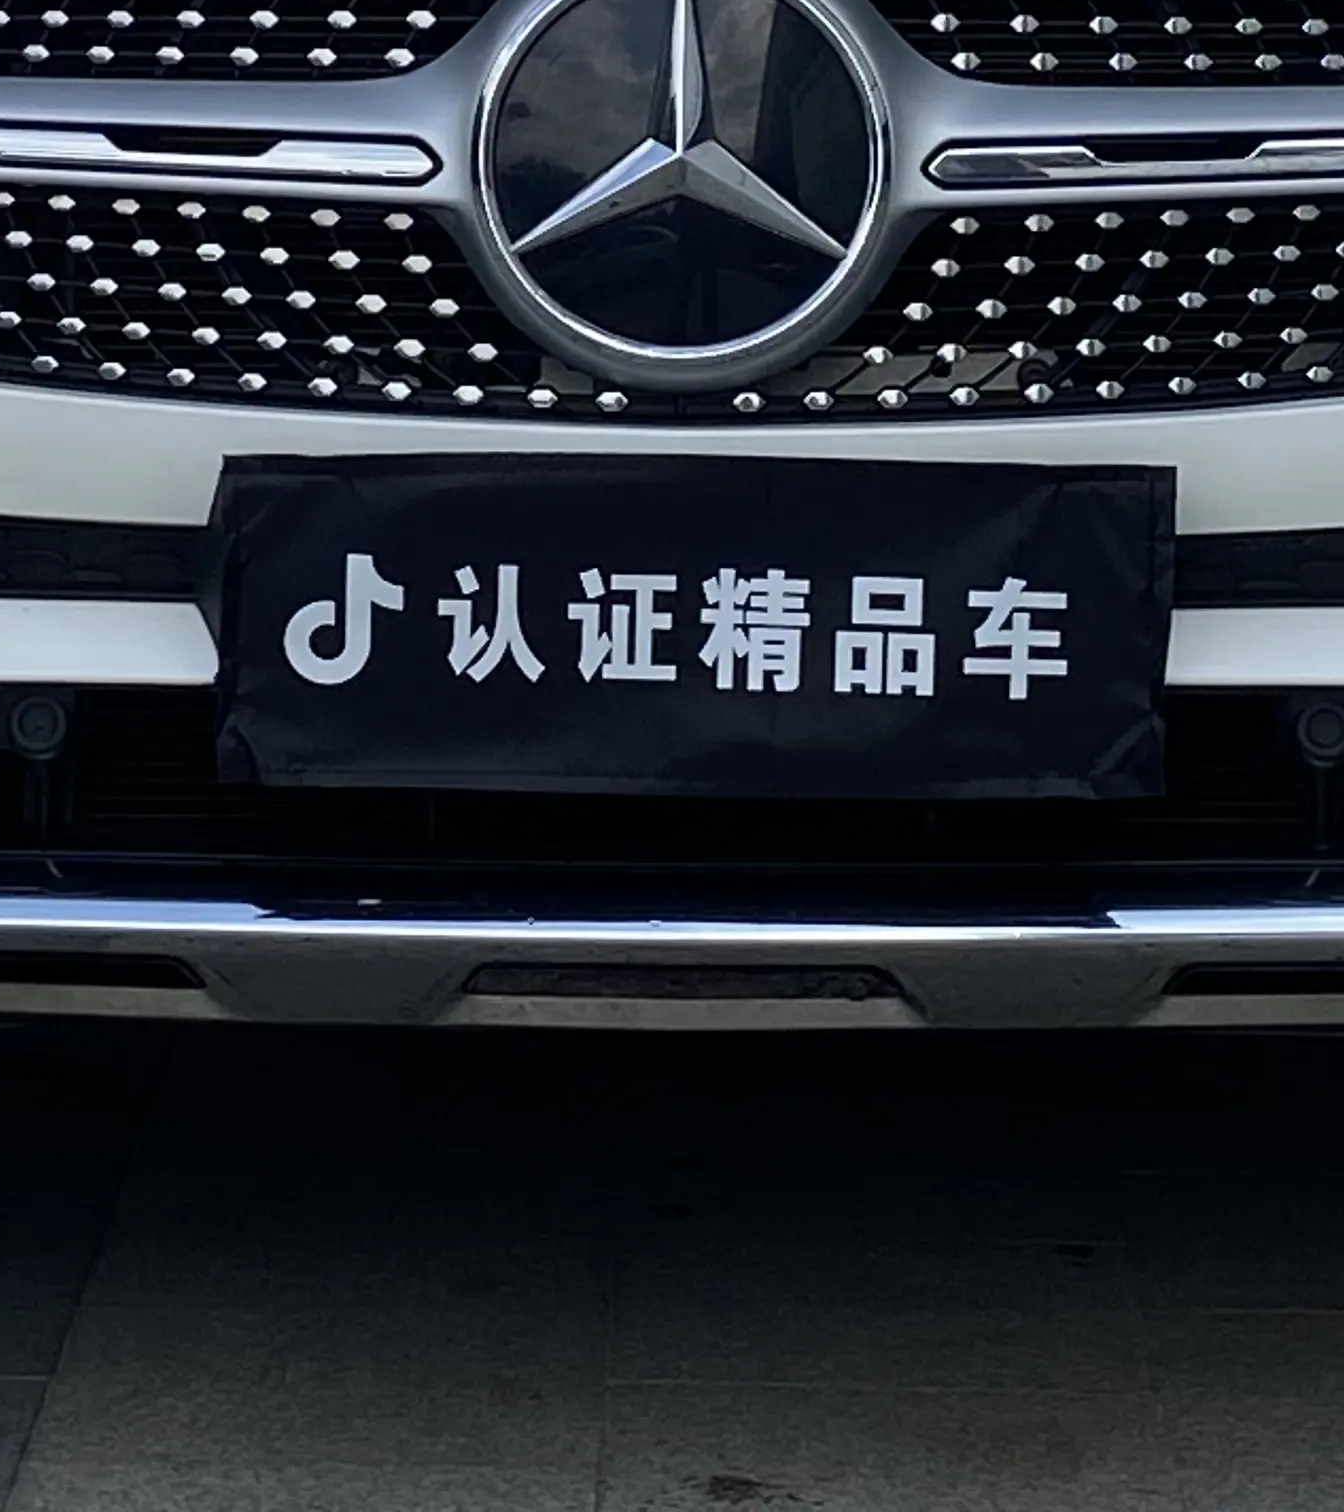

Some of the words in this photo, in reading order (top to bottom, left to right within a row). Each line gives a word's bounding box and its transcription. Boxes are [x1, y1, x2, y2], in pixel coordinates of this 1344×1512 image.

[438, 564, 1068, 700] 认证精品车
